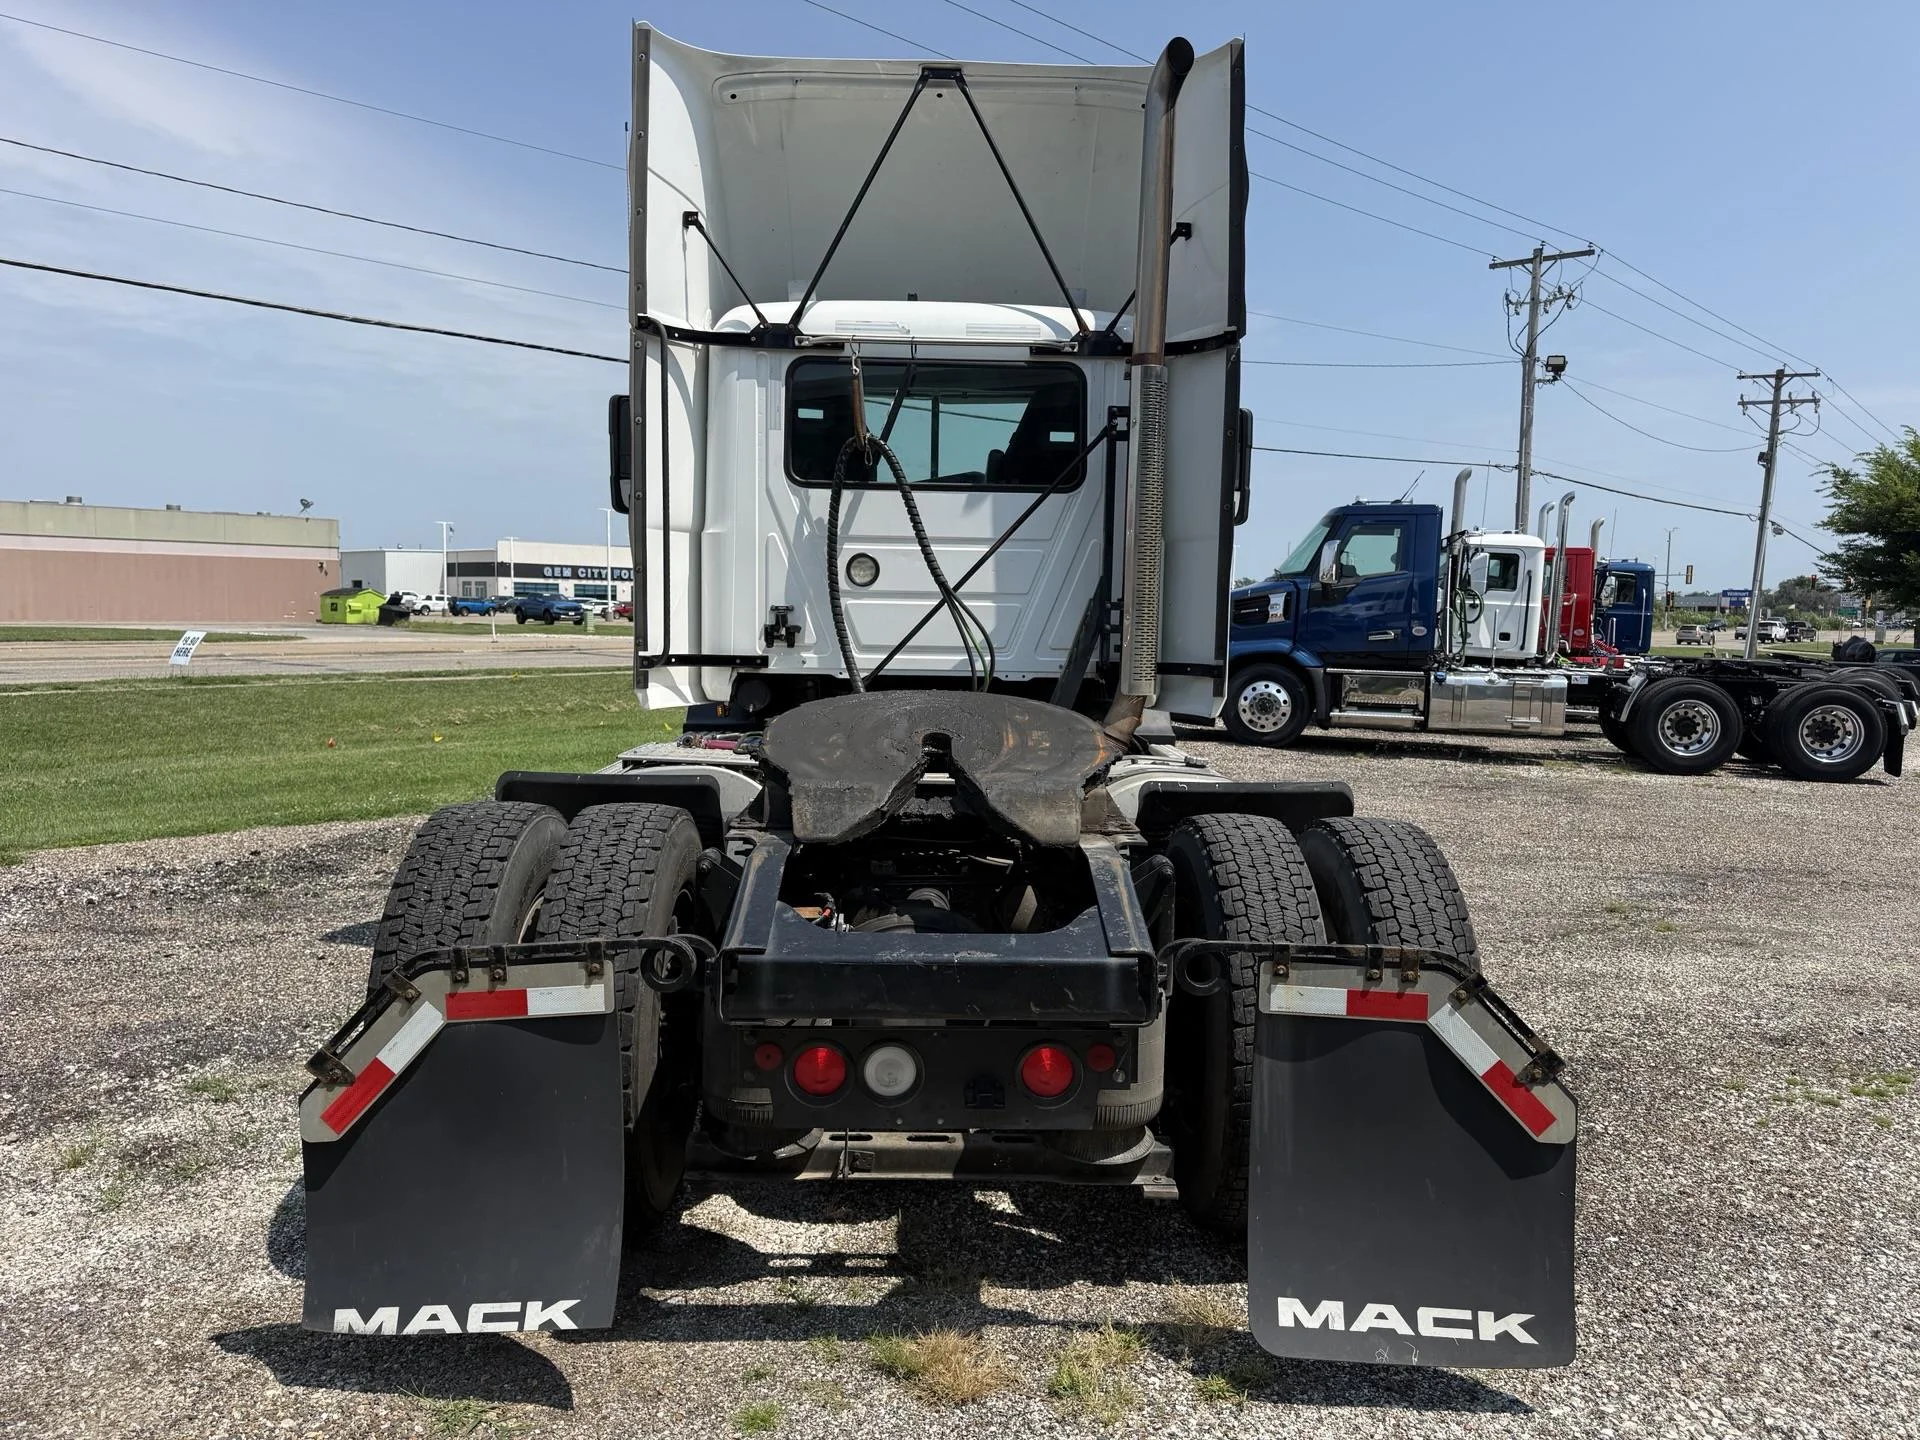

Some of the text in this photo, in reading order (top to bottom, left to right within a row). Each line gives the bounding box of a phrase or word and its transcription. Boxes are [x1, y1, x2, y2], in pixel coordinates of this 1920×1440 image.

[543, 566, 572, 577] GEM
[577, 567, 608, 579] CITY
[333, 1300, 581, 1335] MACK
[1278, 1297, 1539, 1344] MACK
